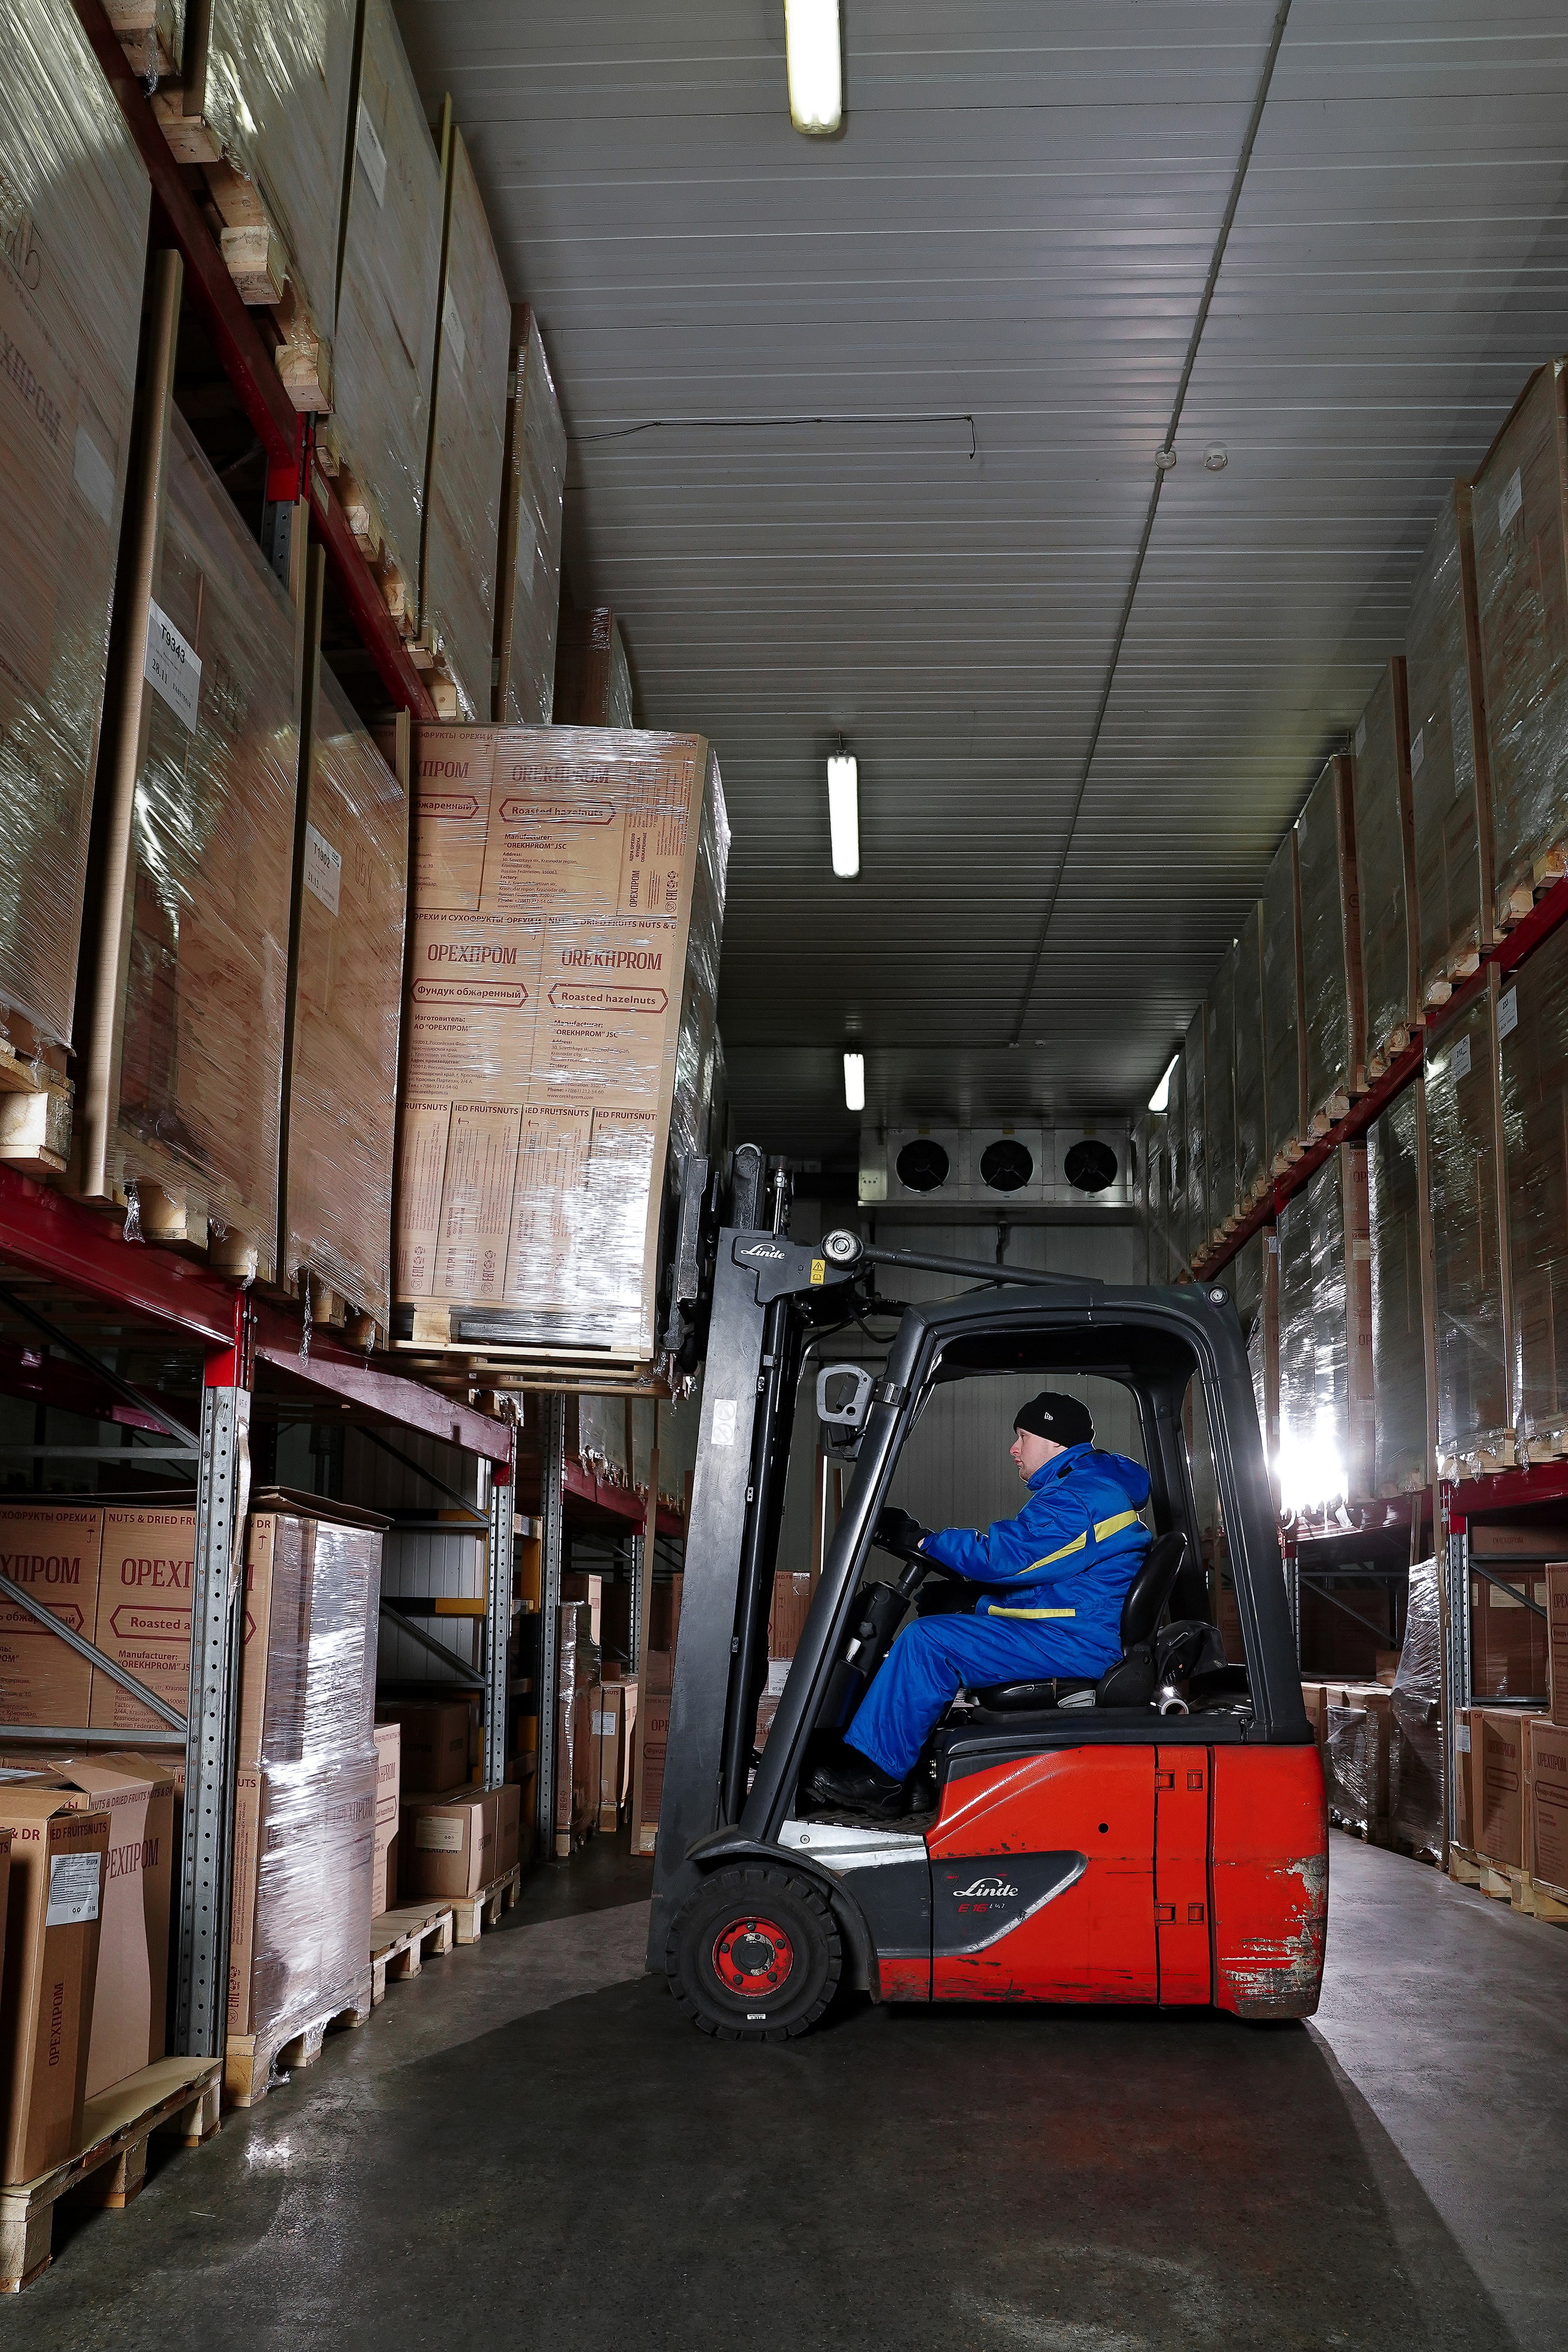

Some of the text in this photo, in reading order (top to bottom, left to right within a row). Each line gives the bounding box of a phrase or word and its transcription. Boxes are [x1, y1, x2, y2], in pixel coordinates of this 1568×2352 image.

[160, 623, 186, 664] T9343
[152, 658, 168, 684] 28.11
[512, 806, 603, 816] Roasted hazelnuts
[313, 842, 331, 869] T1902
[307, 870, 320, 889] 21.12
[629, 870, 640, 908] ОРЕХПРОМ
[428, 944, 518, 965] ОРЕХПРОМ
[561, 949, 663, 970] OREKHPROM
[417, 986, 521, 998] Фундук обжаренный
[561, 992, 656, 1005] Roasted hazelnuts
[470, 1106, 519, 1115] FRUITSNUTS
[540, 1107, 589, 1117] FRUITSNUTS
[740, 1243, 786, 1260] Linde
[0, 1510, 96, 1523] ХОФРУКТЫ ОРЕХИ И
[108, 1513, 135, 1522] NUTS
[138, 1515, 145, 1523] &
[147, 1515, 178, 1525] DRIED
[256, 1520, 271, 1529] DR
[0, 1554, 81, 1585] ХПРОМ
[130, 1616, 181, 1629] Roasted
[118, 1649, 178, 1660] Manufacturer:
[118, 1660, 180, 1670] “OREKHPROM”
[238, 1778, 257, 1788] UTS
[91, 1799, 105, 1810] NUTS
[106, 1798, 111, 1807] &
[111, 1795, 128, 1807] DRIED
[128, 1791, 146, 1804] FRUITS
[11, 1828, 40, 1841] & DR
[50, 1822, 107, 1841] IED FRUITSNUTS
[952, 1877, 1019, 1897] Linde
[957, 1903, 970, 1913] E
[972, 1903, 989, 1913] 16
[49, 1981, 64, 2067] ОРЕХПРОМ
